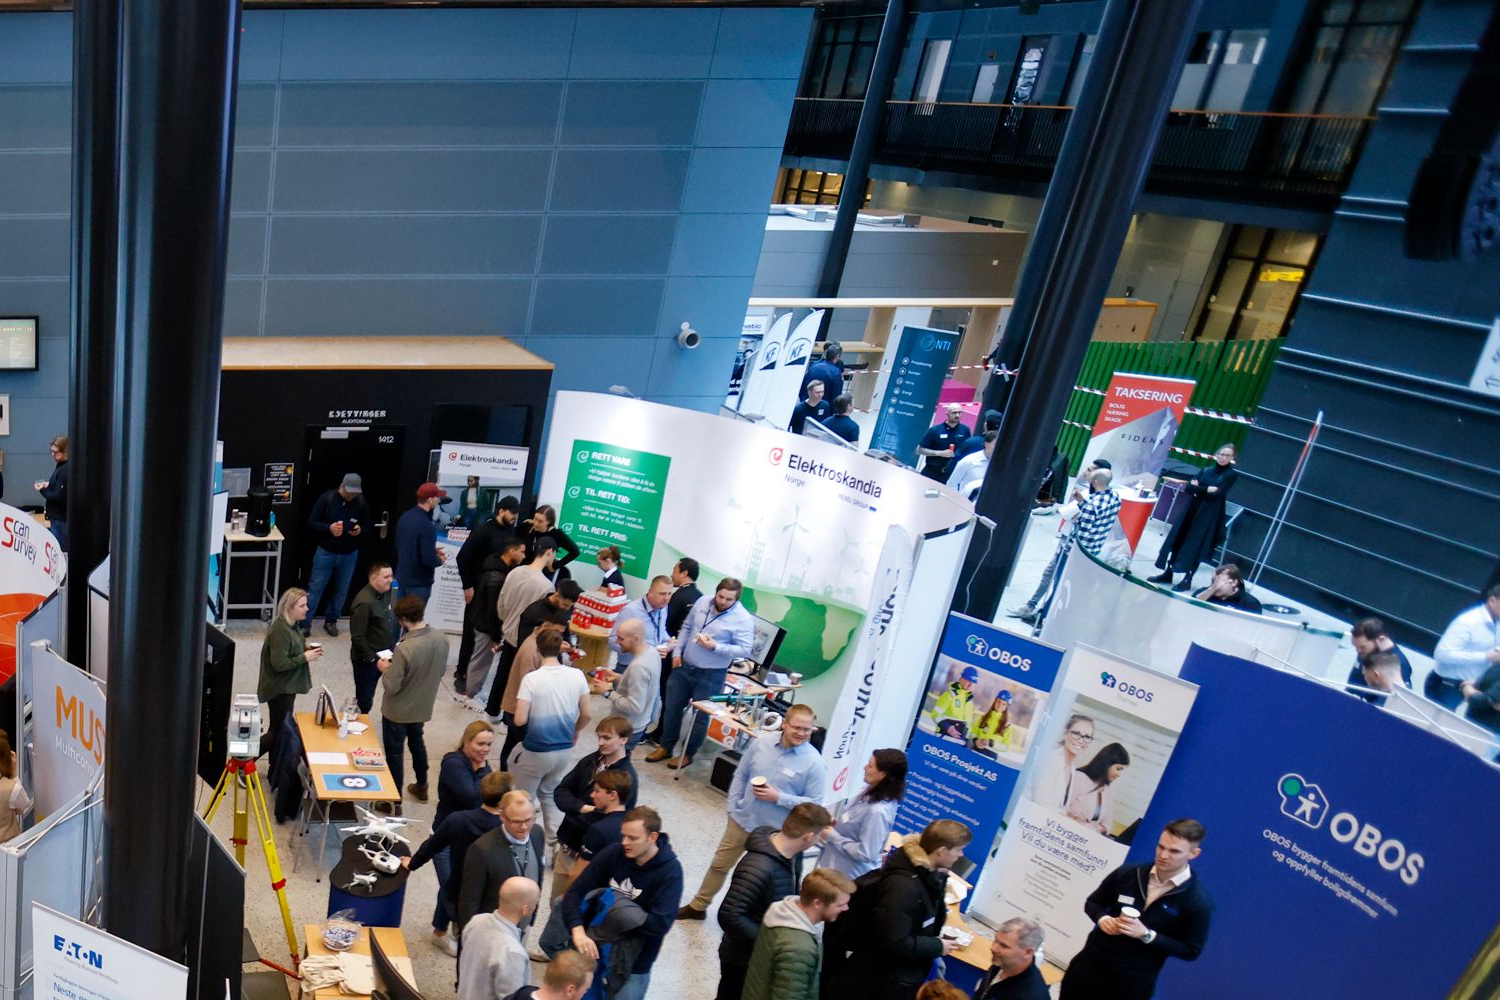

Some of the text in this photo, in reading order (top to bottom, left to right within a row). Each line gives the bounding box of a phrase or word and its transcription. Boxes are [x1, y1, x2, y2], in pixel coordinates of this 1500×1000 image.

[935, 340, 951, 351] NTI
[1115, 387, 1183, 404] TAKSERING
[460, 454, 519, 466] Elektroskandia
[591, 452, 611, 461] RETT
[785, 473, 805, 488] Norge
[788, 454, 882, 498] Elektroskandia
[585, 487, 597, 496] TIL
[598, 490, 617, 500] RETT
[579, 524, 590, 533] TIL
[591, 526, 609, 538] RETT
[989, 647, 1032, 672] OBOS
[1118, 682, 1154, 703] OBOS
[923, 744, 998, 782] OBOS Prosjekt AS
[1019, 817, 1066, 847] framtidens
[1066, 841, 1109, 868] samfunn!
[1046, 817, 1089, 845] Vi bygger
[1022, 830, 1035, 844] Vil
[1034, 836, 1047, 850] du
[1047, 843, 1069, 860] være
[1070, 856, 1097, 874] med?
[1263, 829, 1291, 848] OBOS
[1291, 843, 1321, 865] bygger
[1322, 861, 1366, 893] framtidens
[1330, 812, 1425, 885] OBOS
[1272, 850, 1285, 862] og
[1286, 857, 1323, 882] oppfyller
[53, 934, 102, 969] EATON
[53, 982, 77, 1000] Neste
